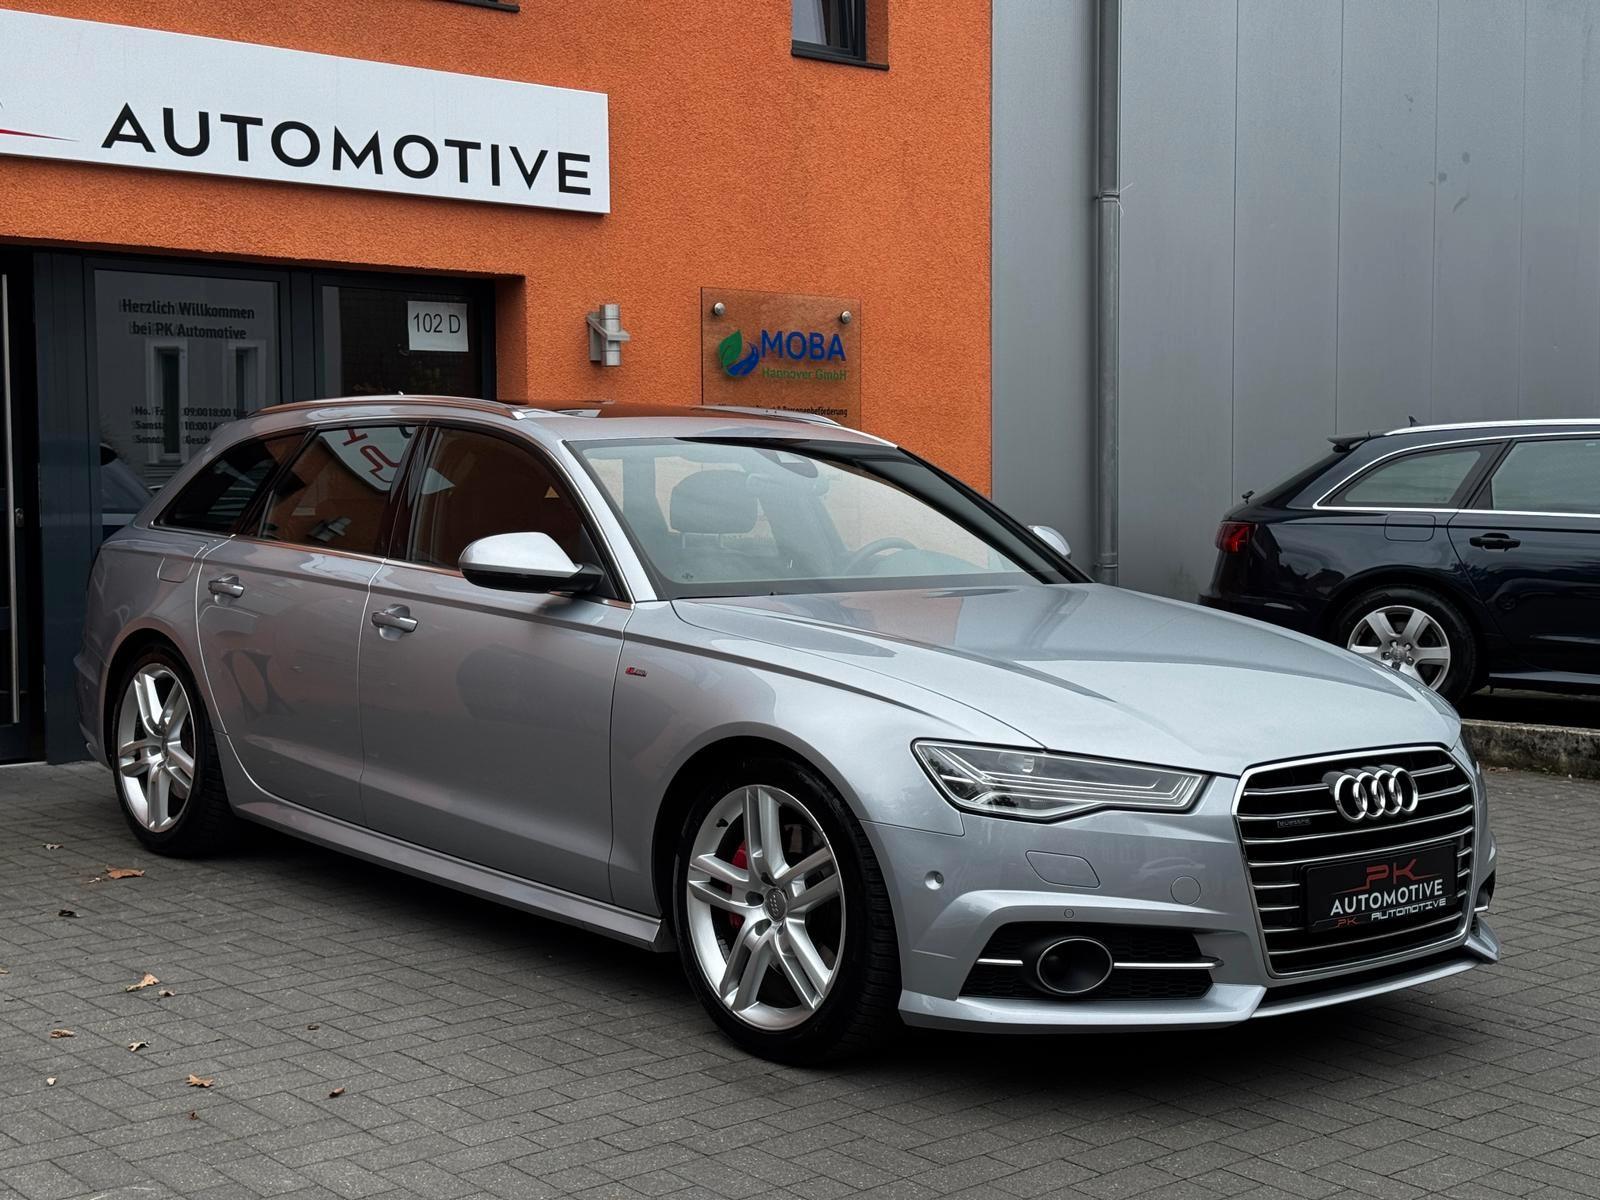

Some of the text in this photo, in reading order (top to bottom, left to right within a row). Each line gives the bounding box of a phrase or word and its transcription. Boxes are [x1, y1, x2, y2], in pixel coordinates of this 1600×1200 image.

[101, 102, 592, 196] AUTOMOTIVE
[122, 298, 255, 319] Herzlich Willkommen
[132, 321, 247, 340] bei PK Automotive
[413, 312, 461, 334] 102 D
[761, 329, 847, 361] MOBA
[763, 368, 847, 381] Hannover GmbH
[1330, 878, 1443, 916] AUTOMOTIVE
[1371, 897, 1447, 921] AUTOMOTIVE
